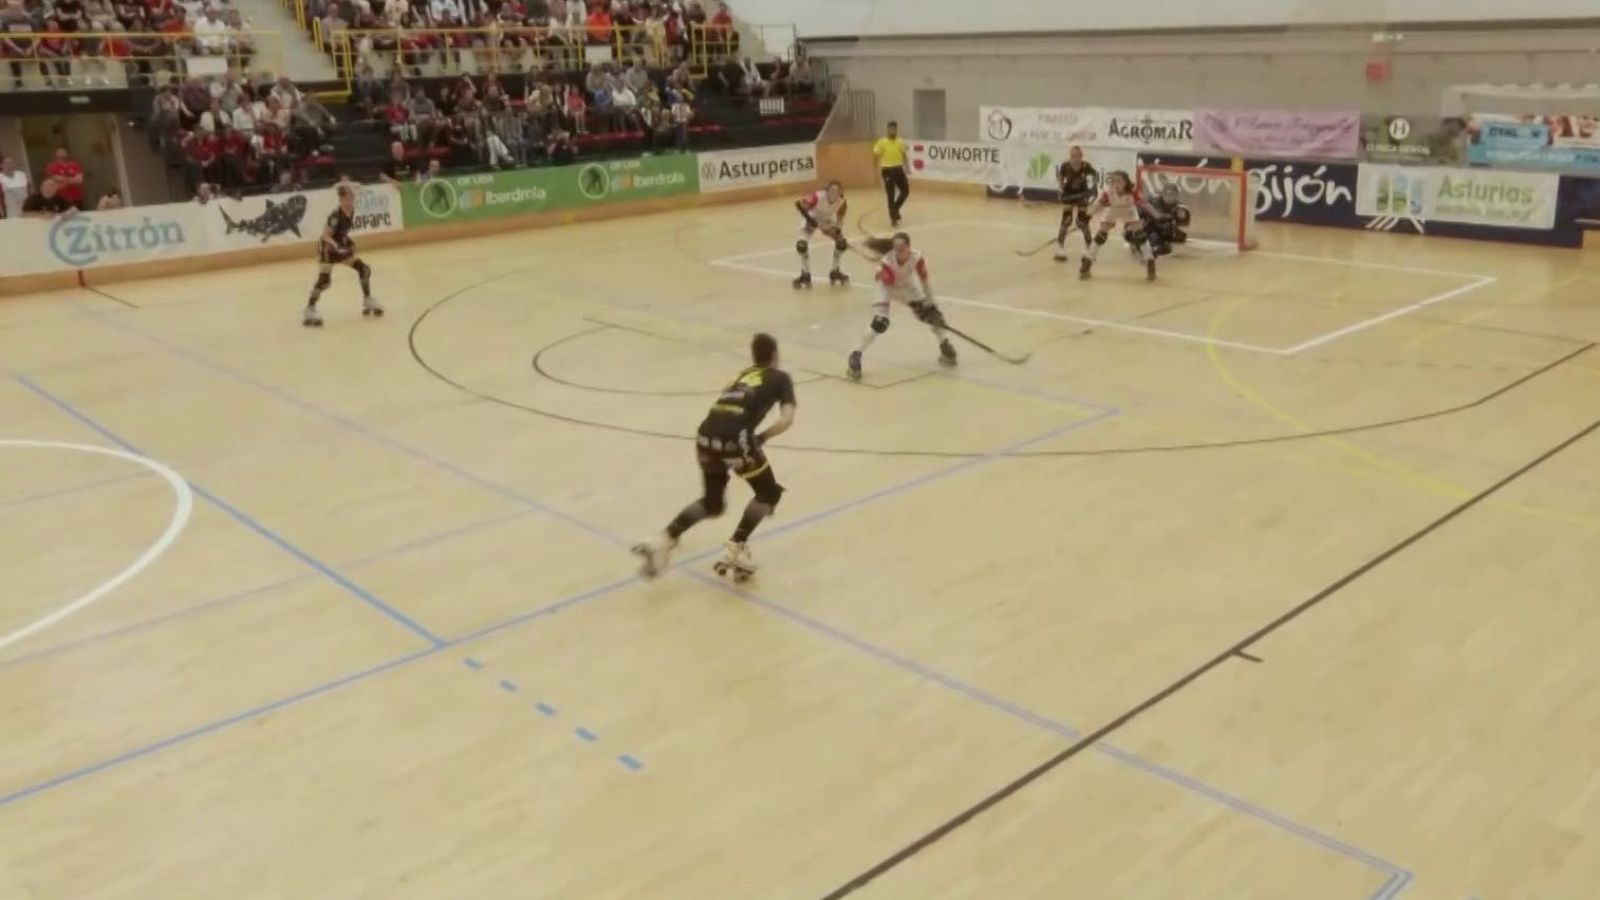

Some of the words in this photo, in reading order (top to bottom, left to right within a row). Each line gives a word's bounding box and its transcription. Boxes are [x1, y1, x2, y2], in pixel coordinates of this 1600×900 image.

[719, 156, 814, 179] Asturpersa
[633, 171, 685, 188] Iberdrola
[1438, 175, 1534, 203] Asturias
[486, 186, 546, 204] Iberdrola
[63, 216, 185, 254] Zitrón
